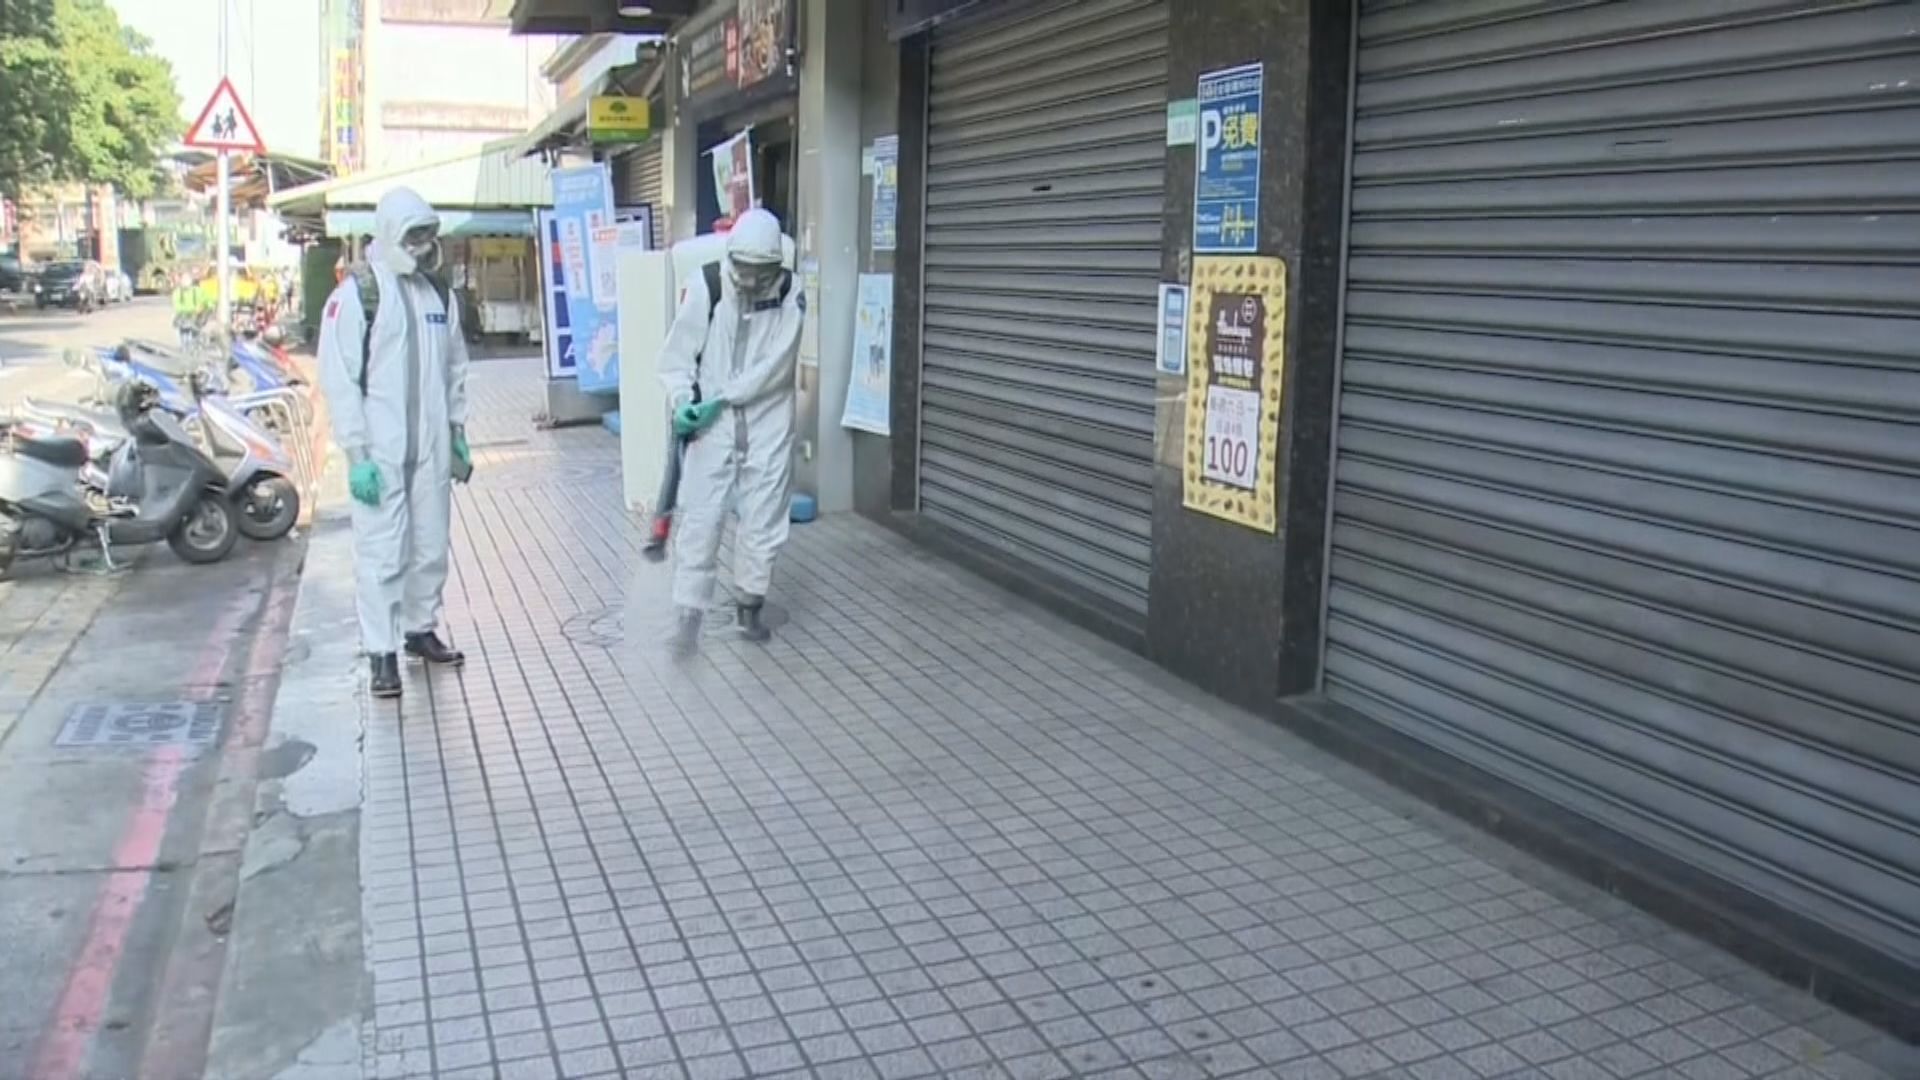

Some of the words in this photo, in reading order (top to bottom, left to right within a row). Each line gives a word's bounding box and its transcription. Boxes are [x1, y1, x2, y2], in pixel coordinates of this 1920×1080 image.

[1201, 110, 1221, 172] P
[1222, 113, 1257, 149] 免費
[1208, 436, 1248, 478] 100
